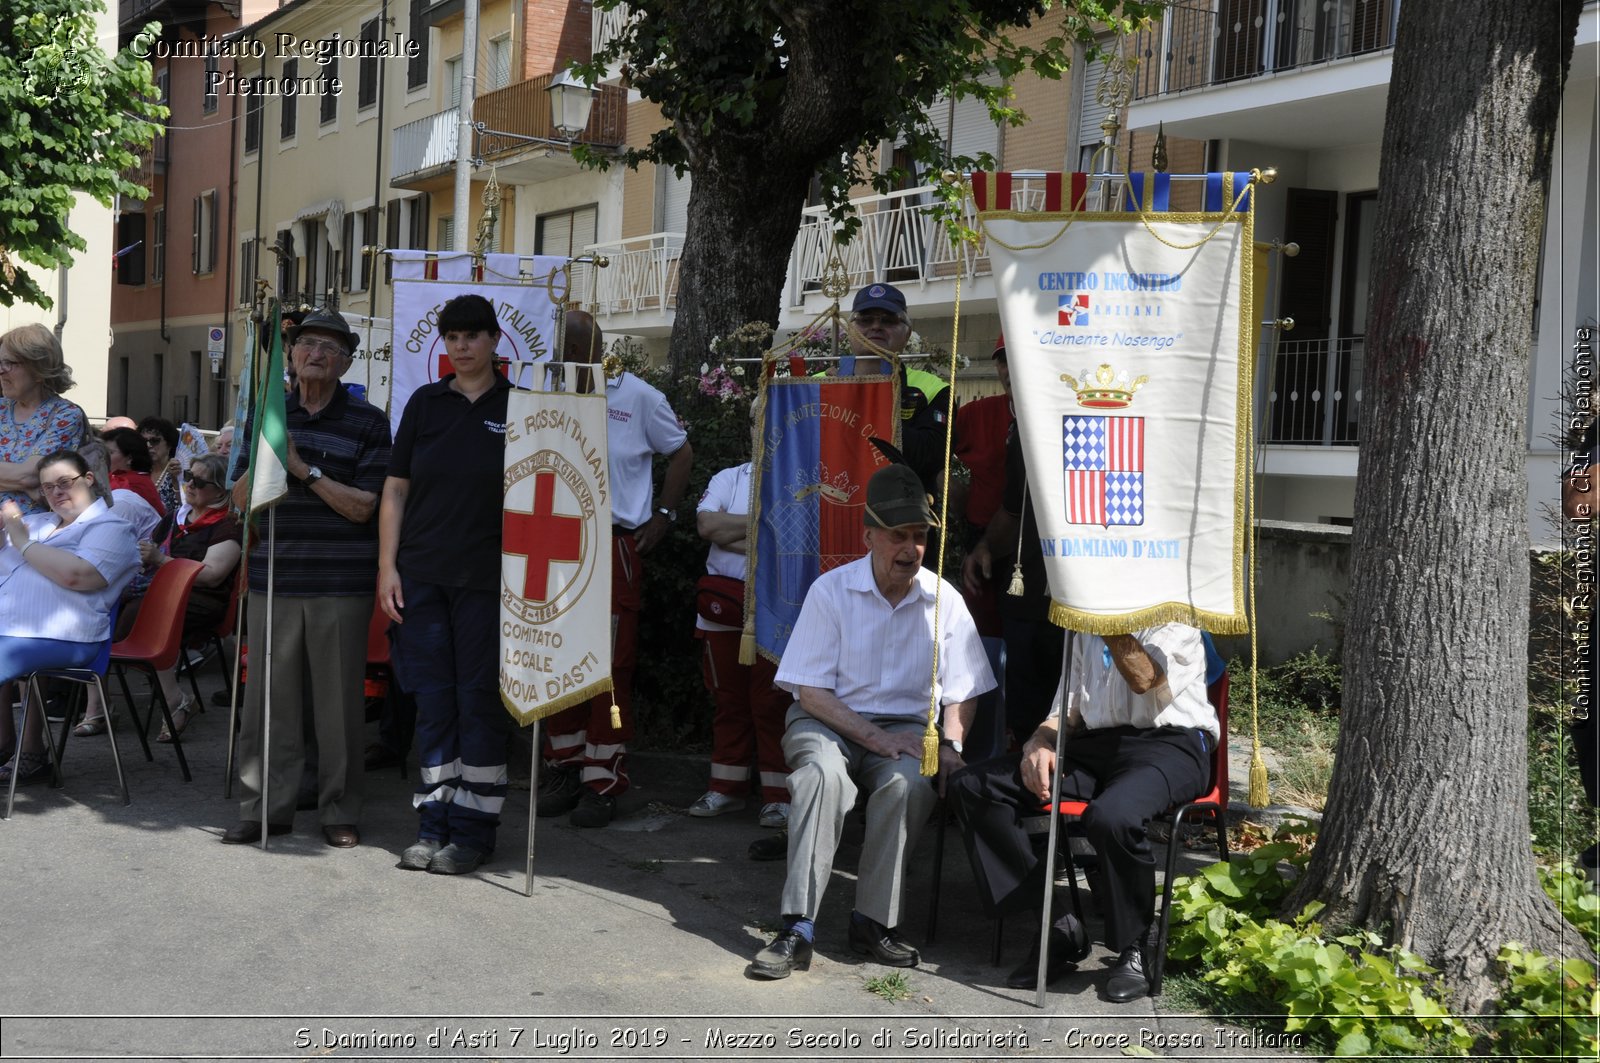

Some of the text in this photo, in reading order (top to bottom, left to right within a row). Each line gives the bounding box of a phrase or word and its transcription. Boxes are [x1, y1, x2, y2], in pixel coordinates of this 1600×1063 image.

[1038, 272, 1181, 292] CENTRO INCONTRO
[1094, 304, 1161, 317] ANZIANI
[497, 302, 548, 360] ITALIANA
[525, 409, 564, 435] ROSSA
[1061, 537, 1128, 557] DAMIANO
[1133, 539, 1180, 559] D'ASTI
[502, 621, 563, 648] COMITATO
[505, 647, 553, 673] LOCALE
